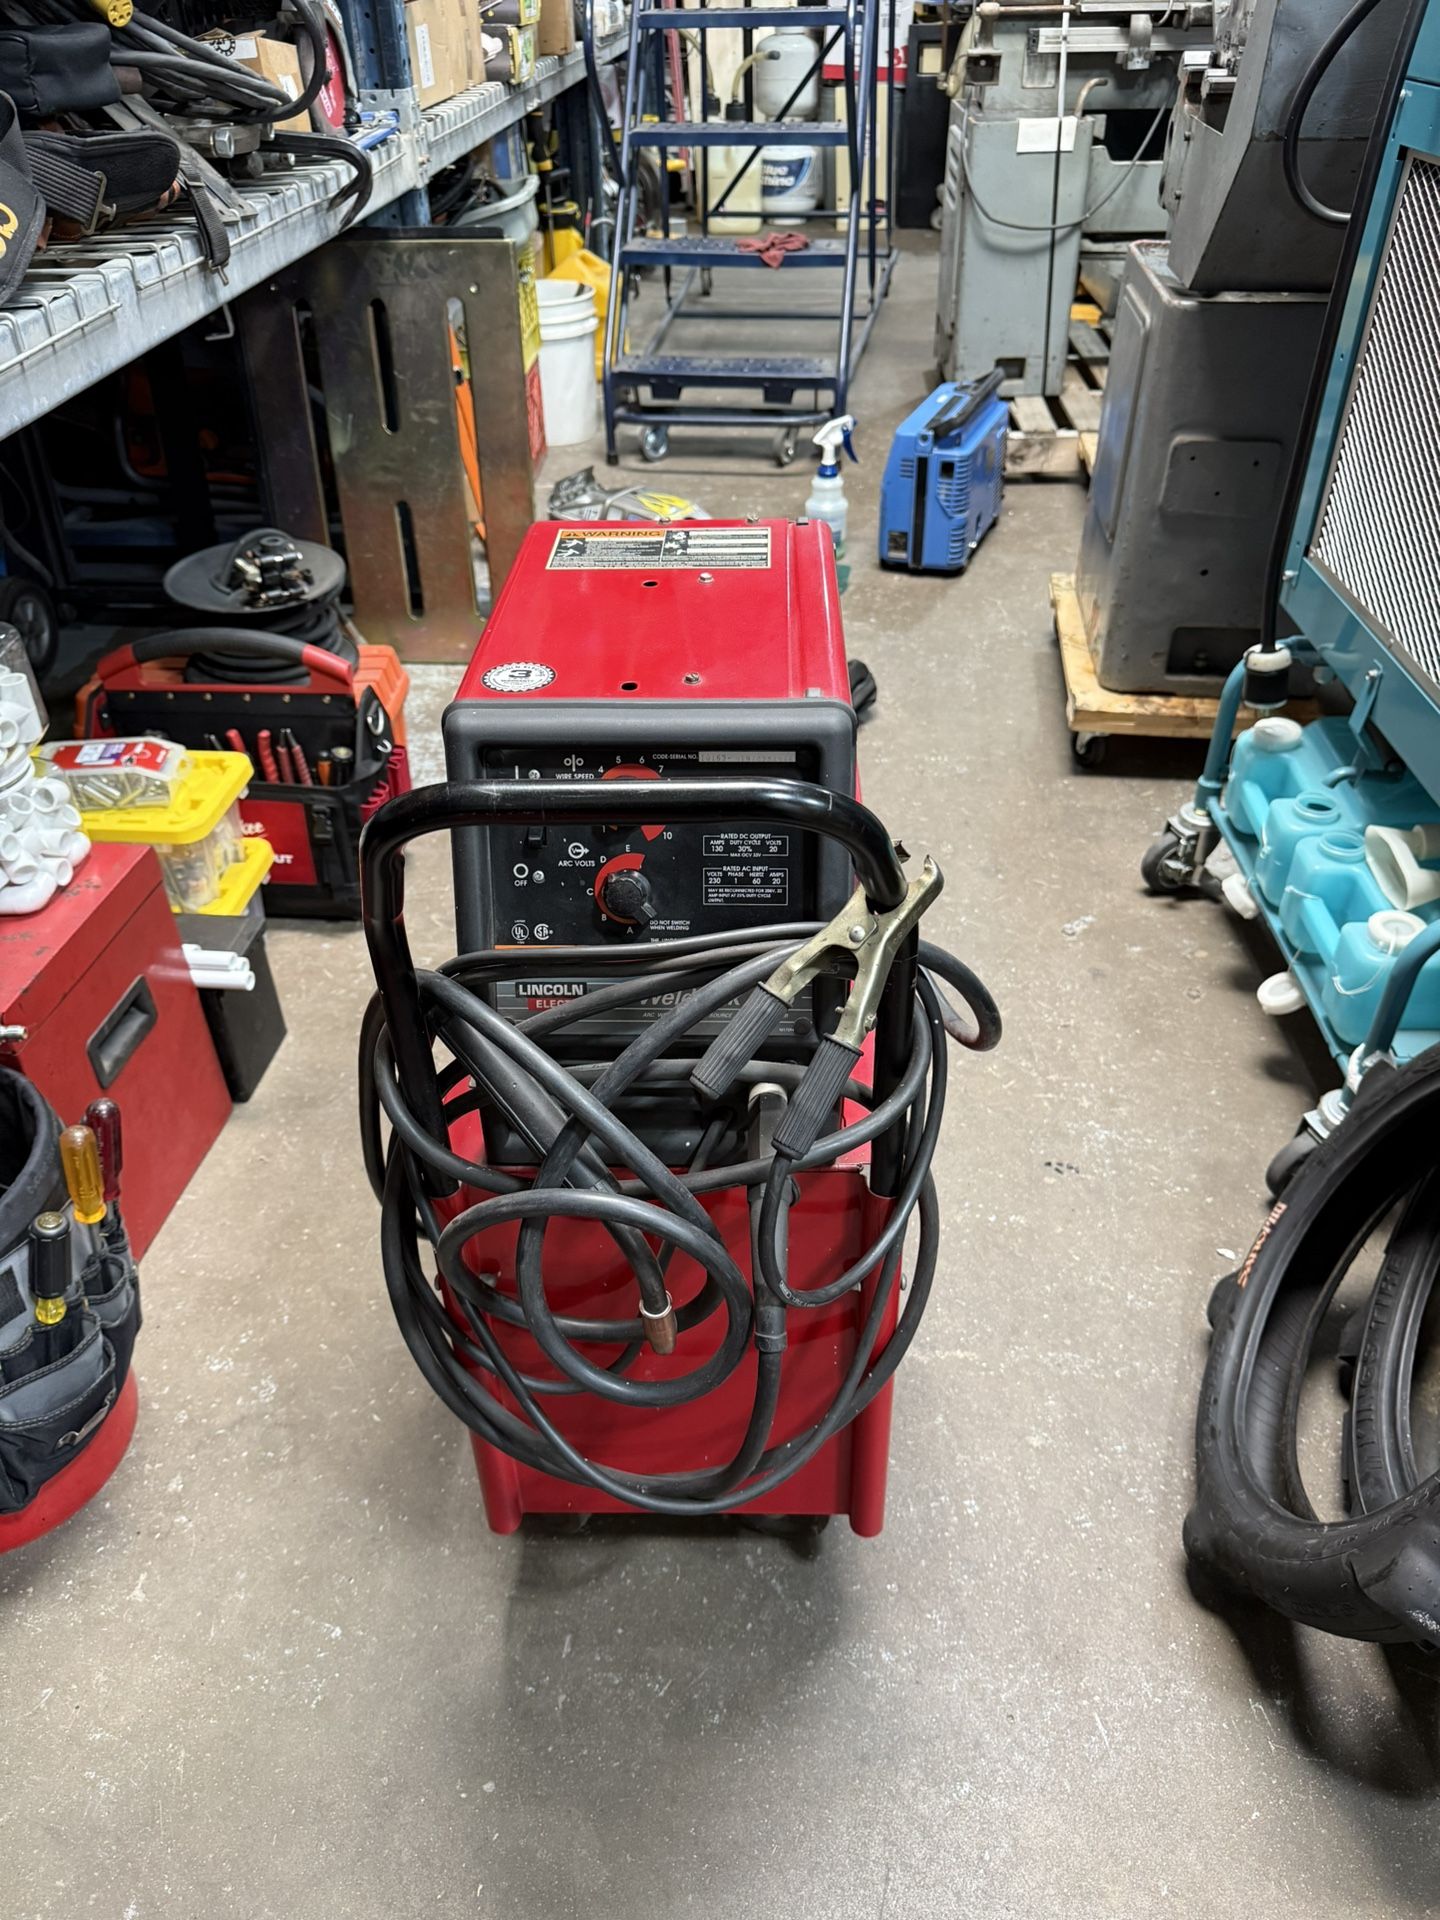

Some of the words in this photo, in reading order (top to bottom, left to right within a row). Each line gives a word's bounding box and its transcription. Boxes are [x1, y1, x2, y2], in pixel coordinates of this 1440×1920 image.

[508, 669, 532, 678] 3
[615, 755, 622, 764] 5
[638, 755, 645, 764] 6
[597, 765, 604, 774] 4
[658, 764, 665, 774] 7
[662, 831, 673, 840] 10
[625, 844, 631, 852] E
[711, 845, 724, 853] 130
[737, 845, 753, 853] 30%
[600, 855, 607, 864] D
[513, 879, 528, 887] OFF
[586, 887, 594, 896] C
[601, 913, 608, 922] B
[626, 926, 634, 934] A
[519, 983, 584, 996] LINCOLN
